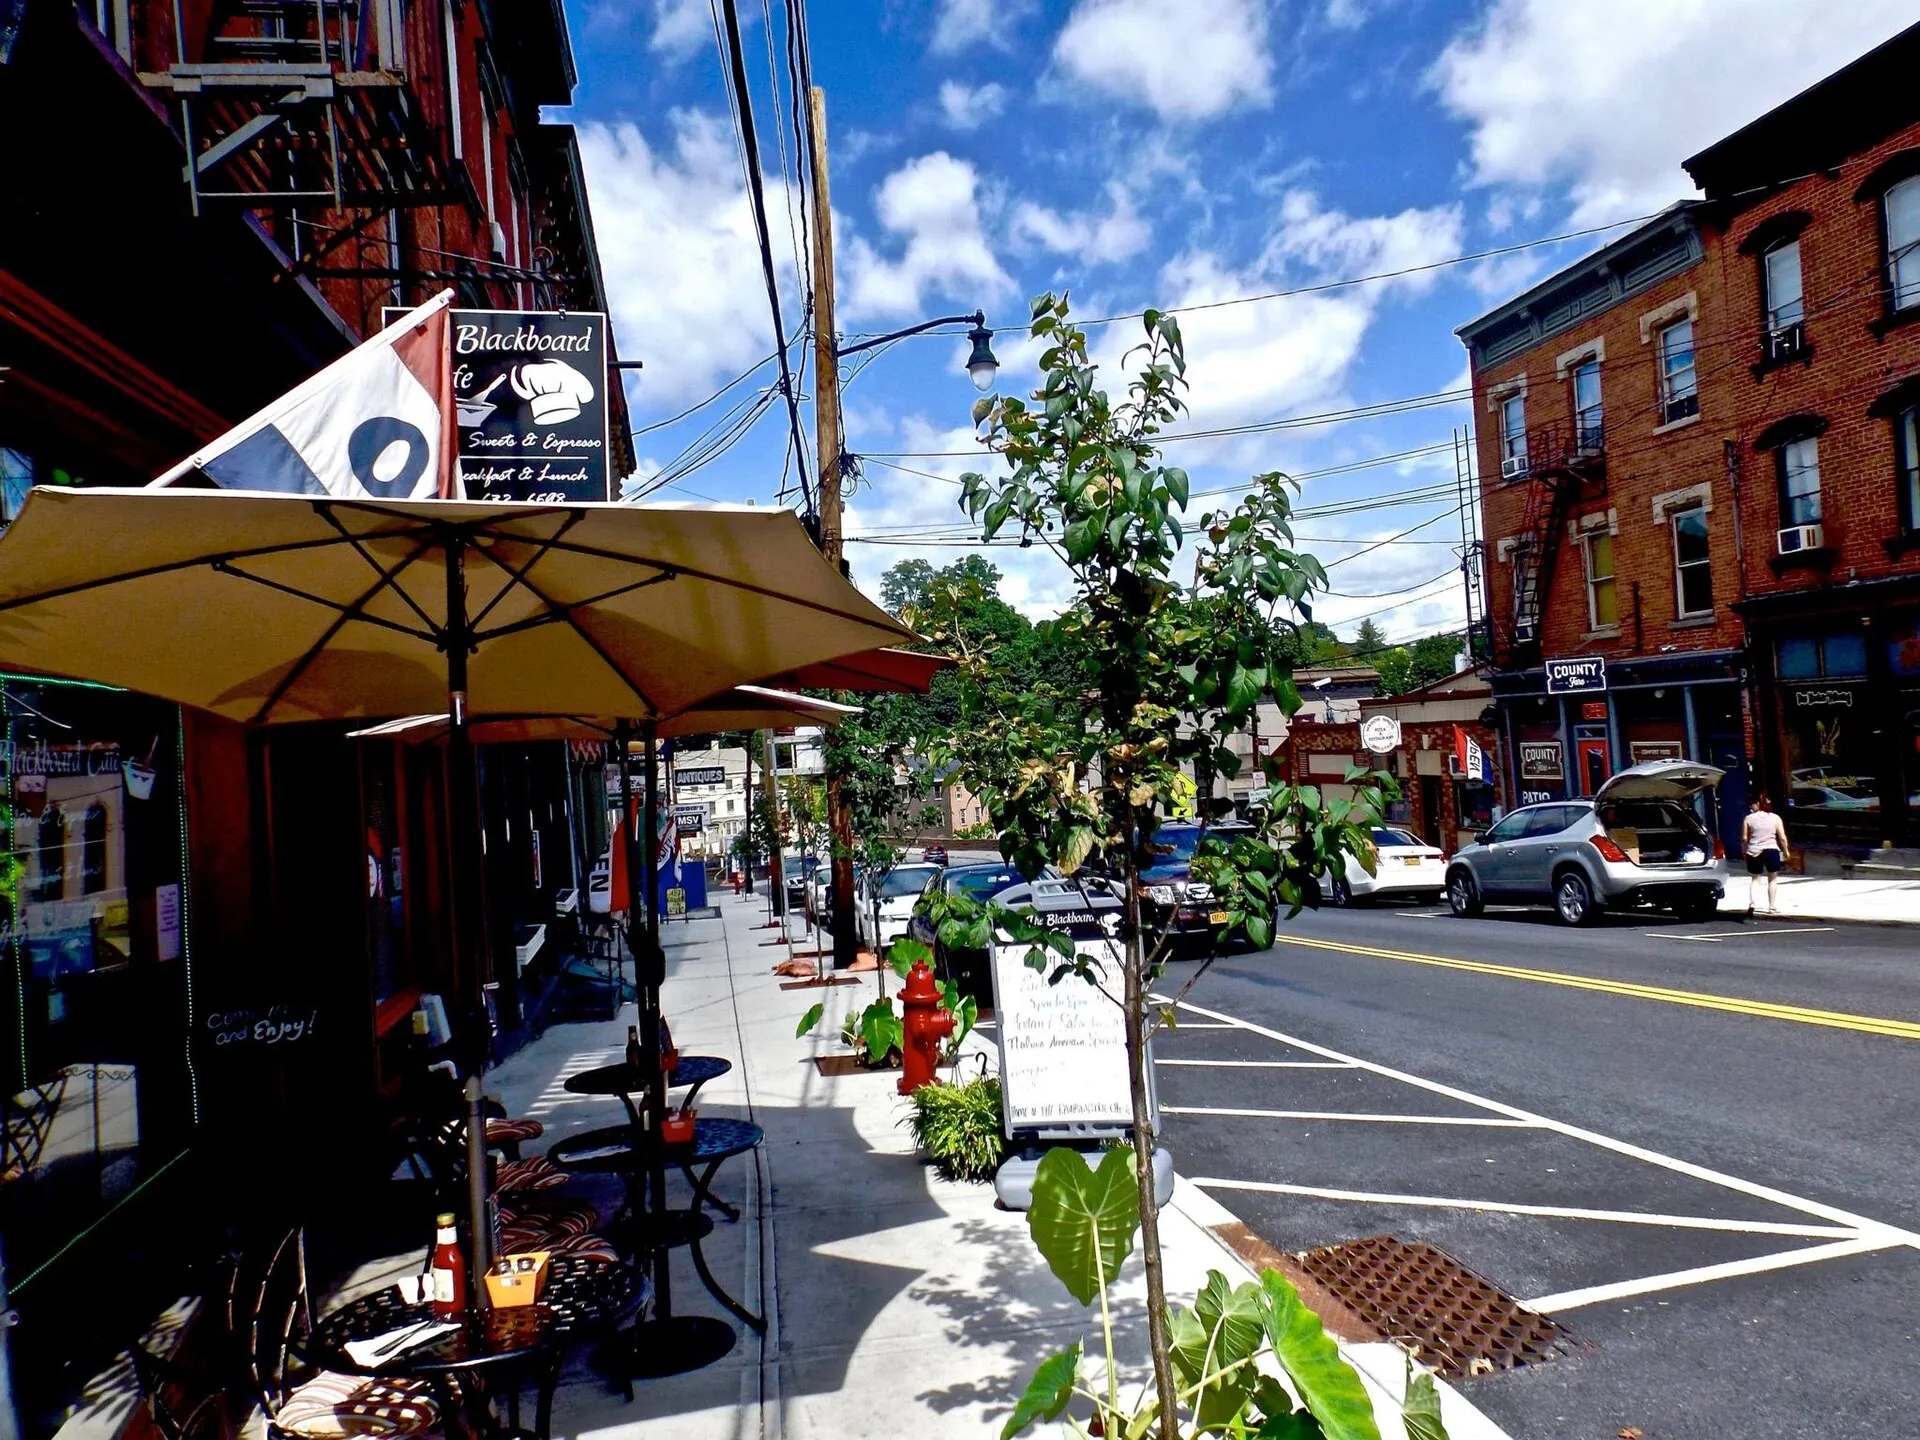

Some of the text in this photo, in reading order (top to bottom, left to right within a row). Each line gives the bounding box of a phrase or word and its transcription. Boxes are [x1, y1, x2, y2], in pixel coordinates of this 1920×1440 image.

[455, 324, 593, 354] Blackboard
[468, 431, 602, 453] Sweets & Espresso
[462, 463, 588, 488] eakfast & Lunch
[1553, 663, 1597, 679] COUNTY
[1525, 749, 1557, 763] COUNTY
[676, 770, 723, 784] ANTIQUES
[678, 815, 700, 825] MSV
[253, 1009, 318, 1045] Enjoy!
